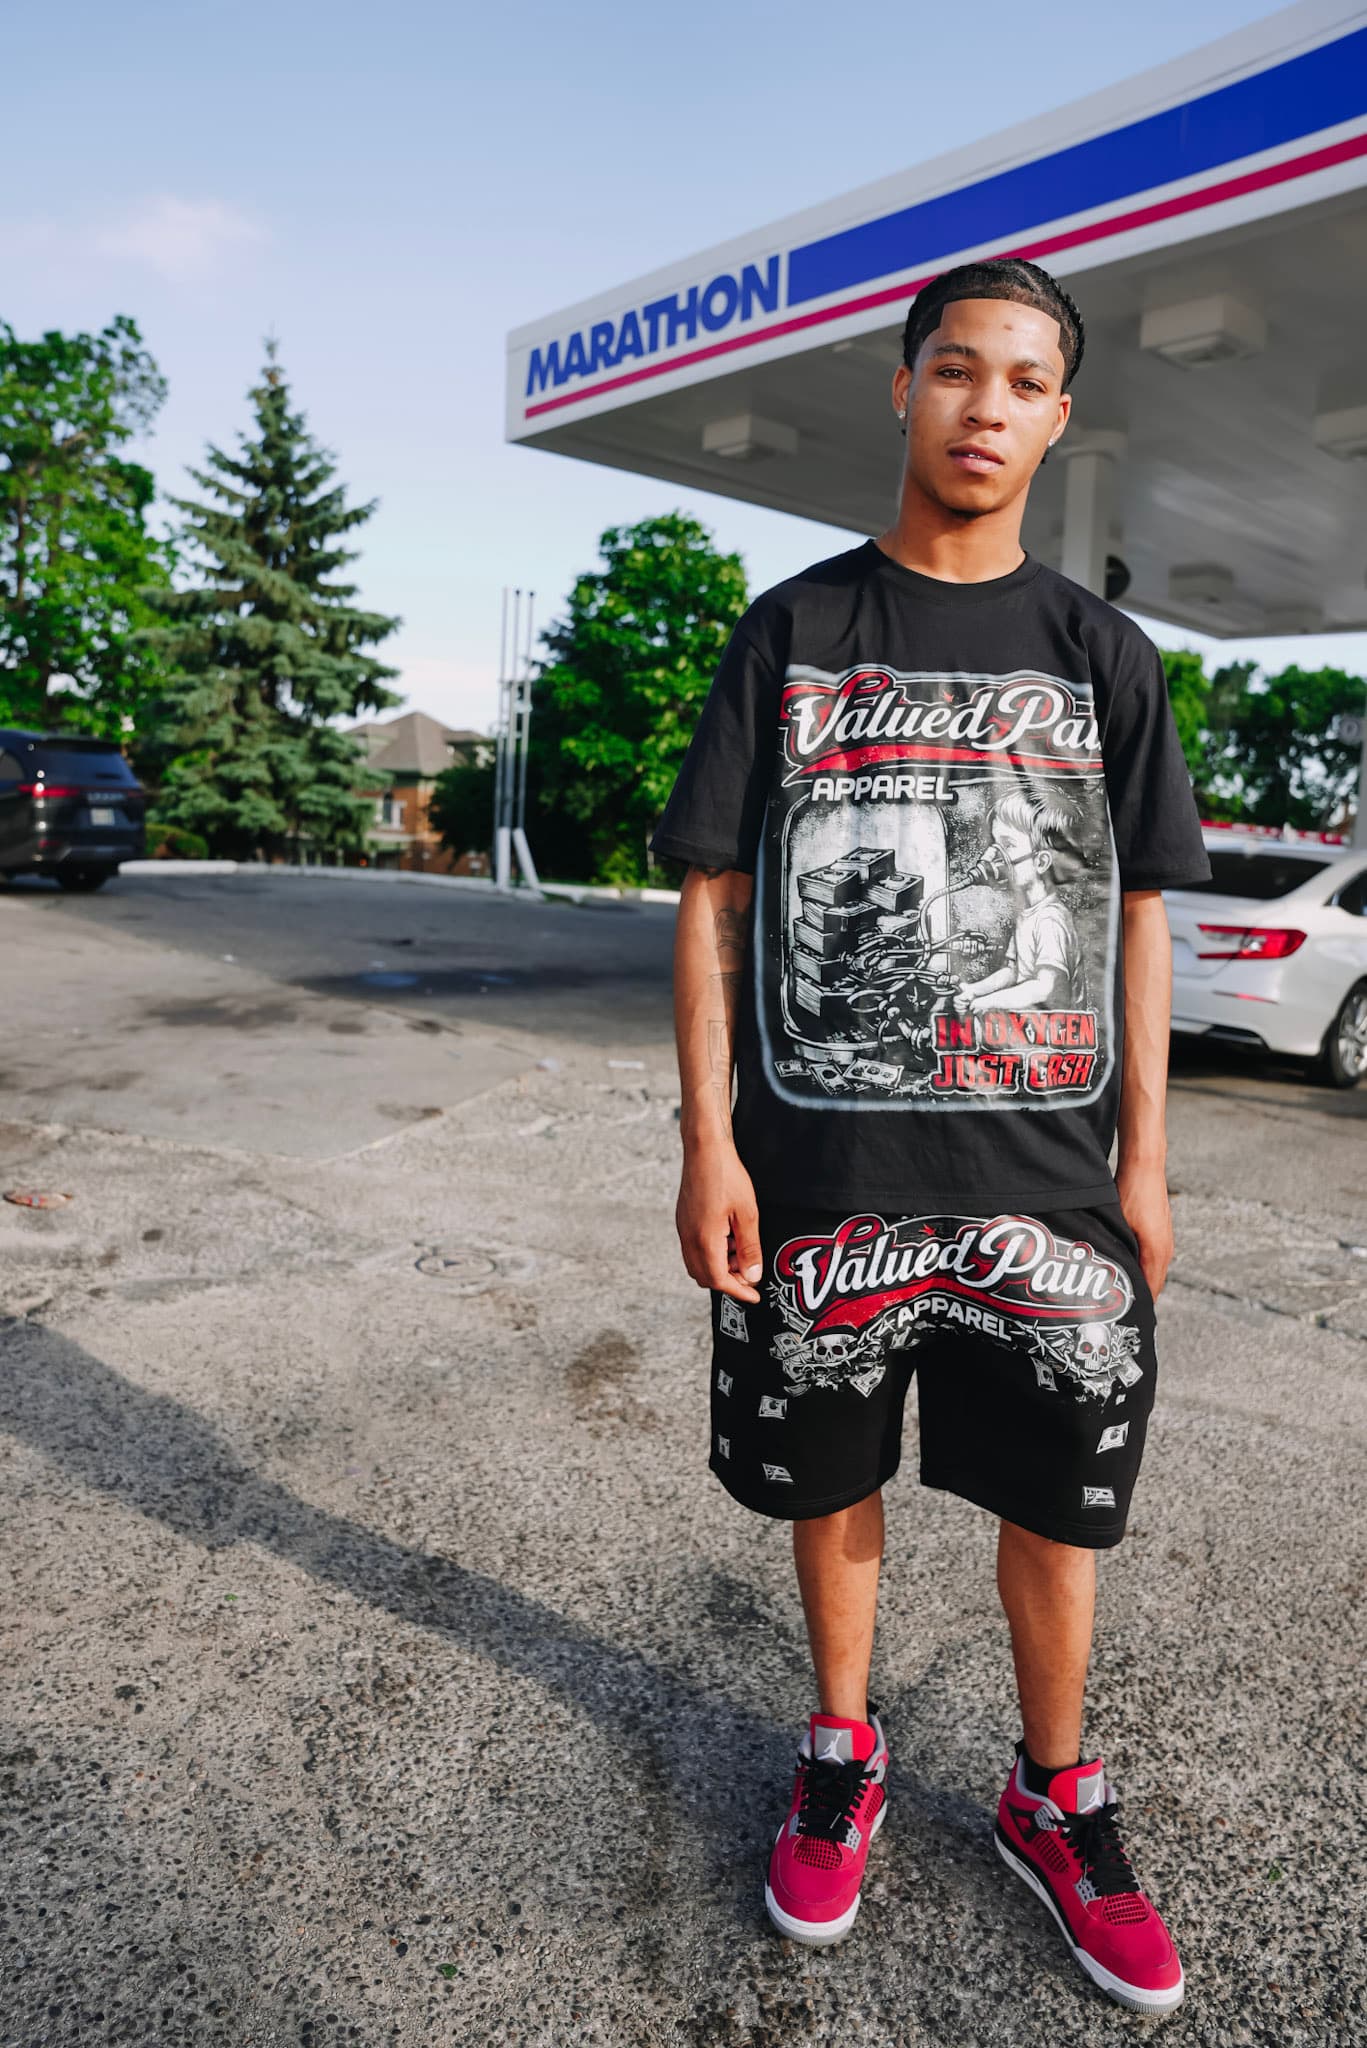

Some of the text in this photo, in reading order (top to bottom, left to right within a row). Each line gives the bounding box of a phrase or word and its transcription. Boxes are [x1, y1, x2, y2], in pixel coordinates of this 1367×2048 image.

[526, 253, 780, 397] MARATHON
[780, 669, 1101, 756] Valued Pai
[812, 775, 953, 801] APPAREL
[984, 1012, 1096, 1046] OXYGEN
[933, 1053, 1094, 1088] JUST CASH
[778, 1217, 1110, 1310] Valued Pain
[898, 1297, 1012, 1342] APPAREL
